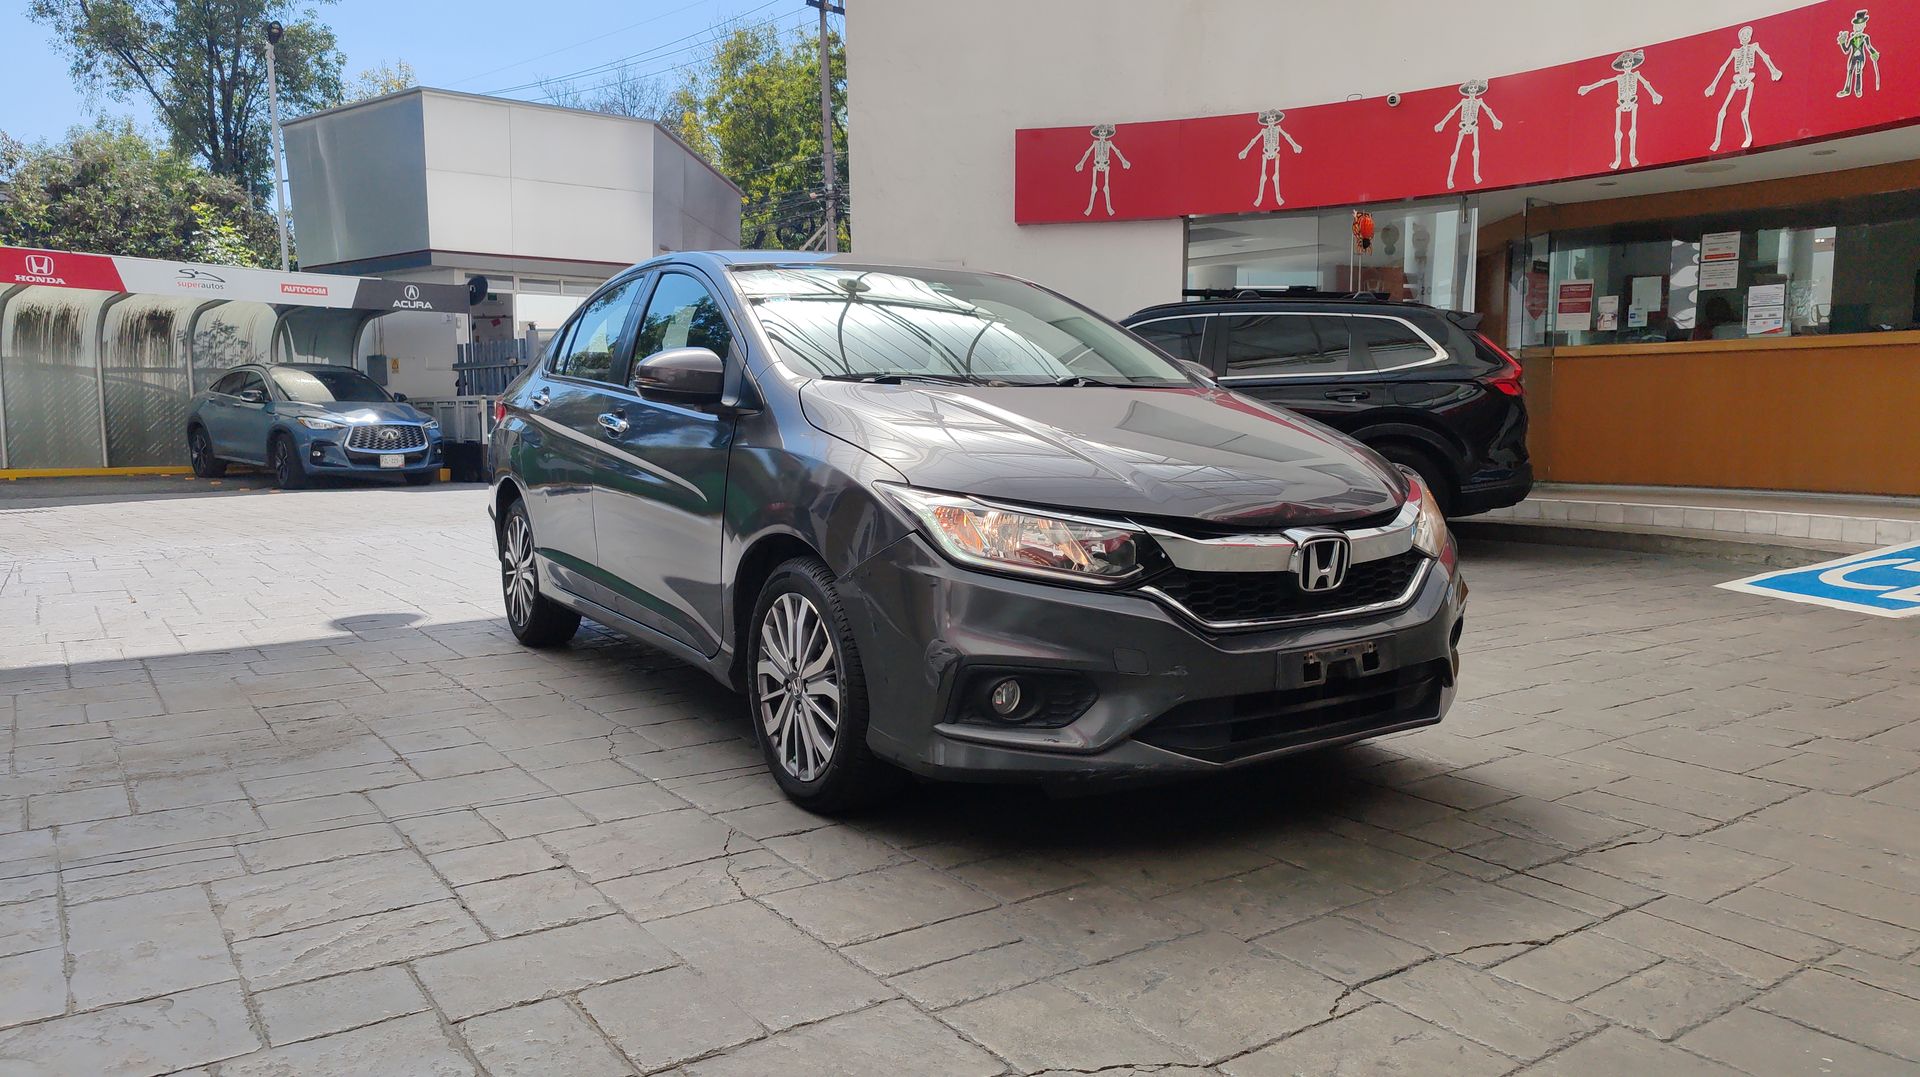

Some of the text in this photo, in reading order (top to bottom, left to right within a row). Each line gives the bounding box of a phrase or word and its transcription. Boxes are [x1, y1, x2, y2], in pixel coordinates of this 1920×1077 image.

[14, 274, 66, 285] HONDA
[176, 280, 225, 290] superautos
[283, 285, 327, 295] AUTOCOM
[392, 299, 433, 309] ACURA
